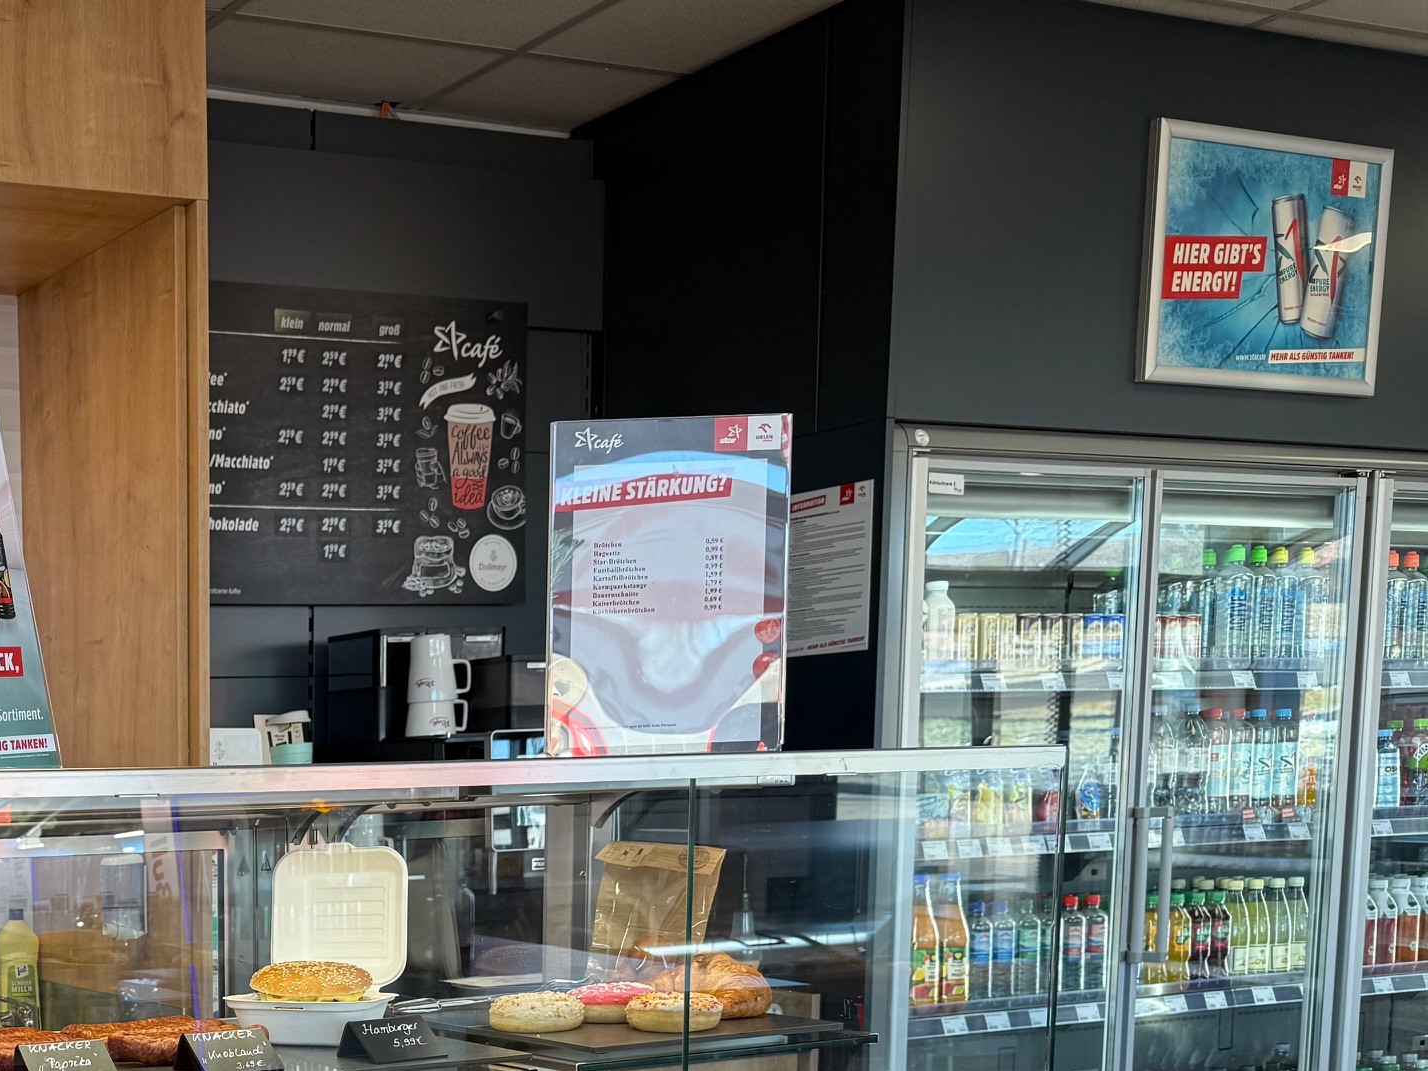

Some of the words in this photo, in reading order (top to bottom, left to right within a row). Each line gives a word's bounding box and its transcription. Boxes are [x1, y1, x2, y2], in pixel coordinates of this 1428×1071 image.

[1173, 243, 1209, 264] HIER
[1213, 243, 1262, 265] GIBT'S
[1171, 270, 1237, 292] ENERGY!
[281, 317, 304, 330] klein
[318, 321, 351, 333] normal
[379, 324, 401, 336] groß
[461, 335, 503, 368] café
[1271, 352, 1288, 361] MEHR
[1289, 352, 1301, 360] ALS
[1302, 351, 1327, 360] GÜNSTIG
[1329, 351, 1354, 360] TANKEN!
[594, 434, 623, 454] café
[719, 437, 737, 445] star
[561, 482, 622, 506] KLEINE
[625, 474, 727, 500] STÄRKUNG?
[1230, 596, 1246, 631] ACTIVE
[10, 738, 47, 749] TANKEN!
[12, 985, 32, 993] MILCH
[192, 1030, 256, 1042] KNACKER
[362, 1022, 417, 1036] Hamburger
[28, 1040, 91, 1053] KNACKER
